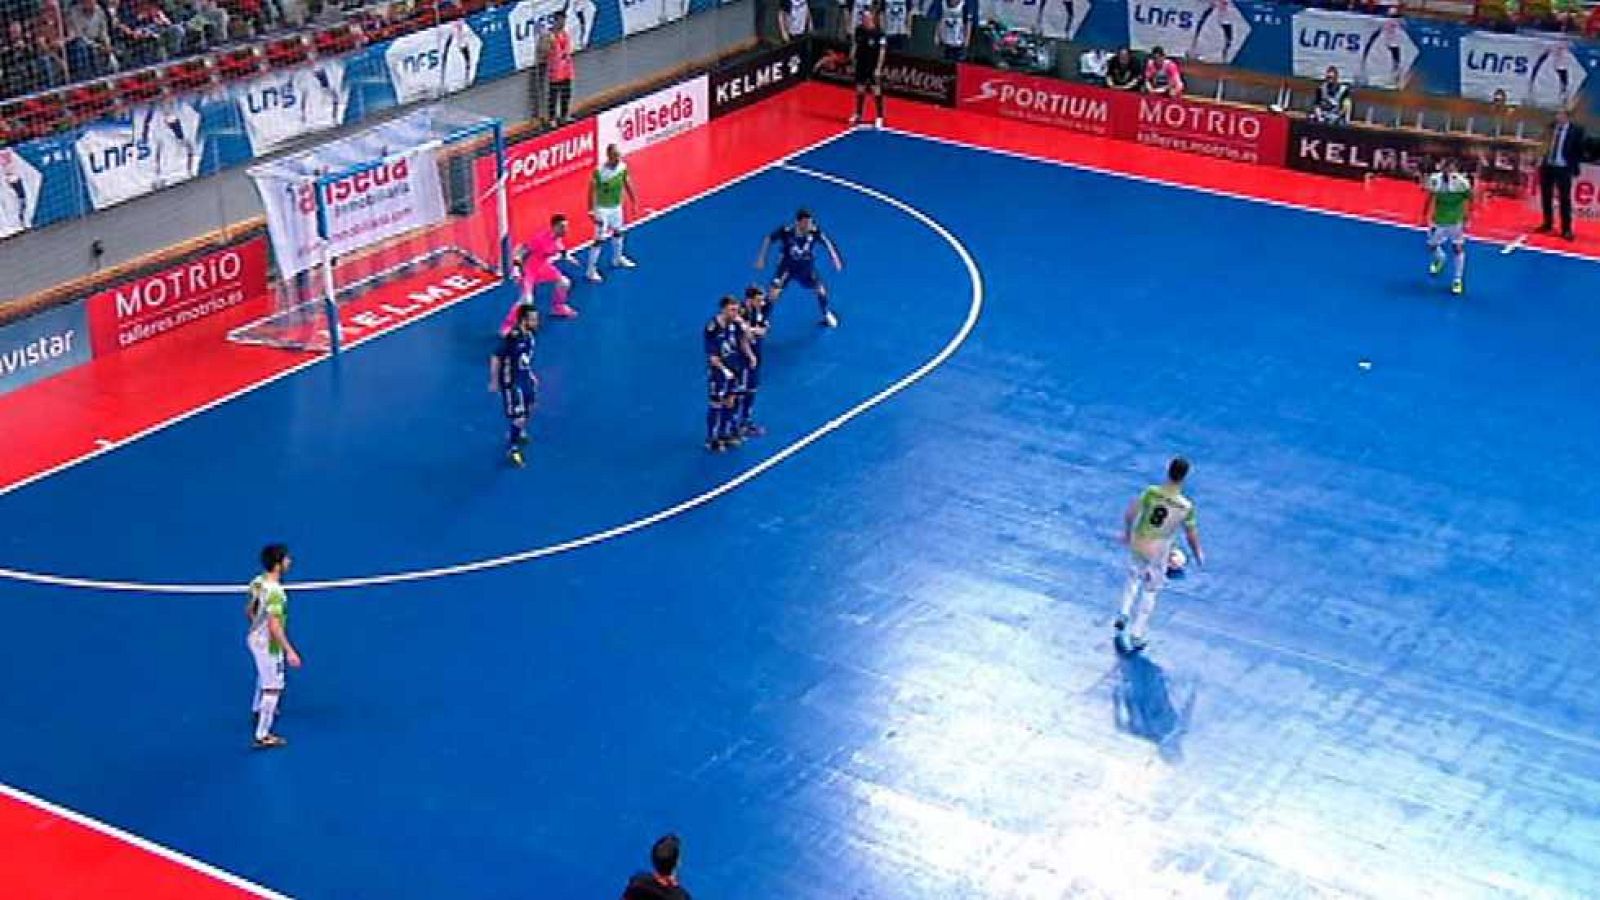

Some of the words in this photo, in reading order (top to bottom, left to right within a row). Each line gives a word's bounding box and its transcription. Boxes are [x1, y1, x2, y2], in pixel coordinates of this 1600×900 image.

[716, 61, 783, 104] KELME
[621, 92, 694, 141] aliseda
[1139, 97, 1260, 139] MOTRIO
[116, 252, 241, 318] MOTRIO
[0, 329, 75, 375] vistar
